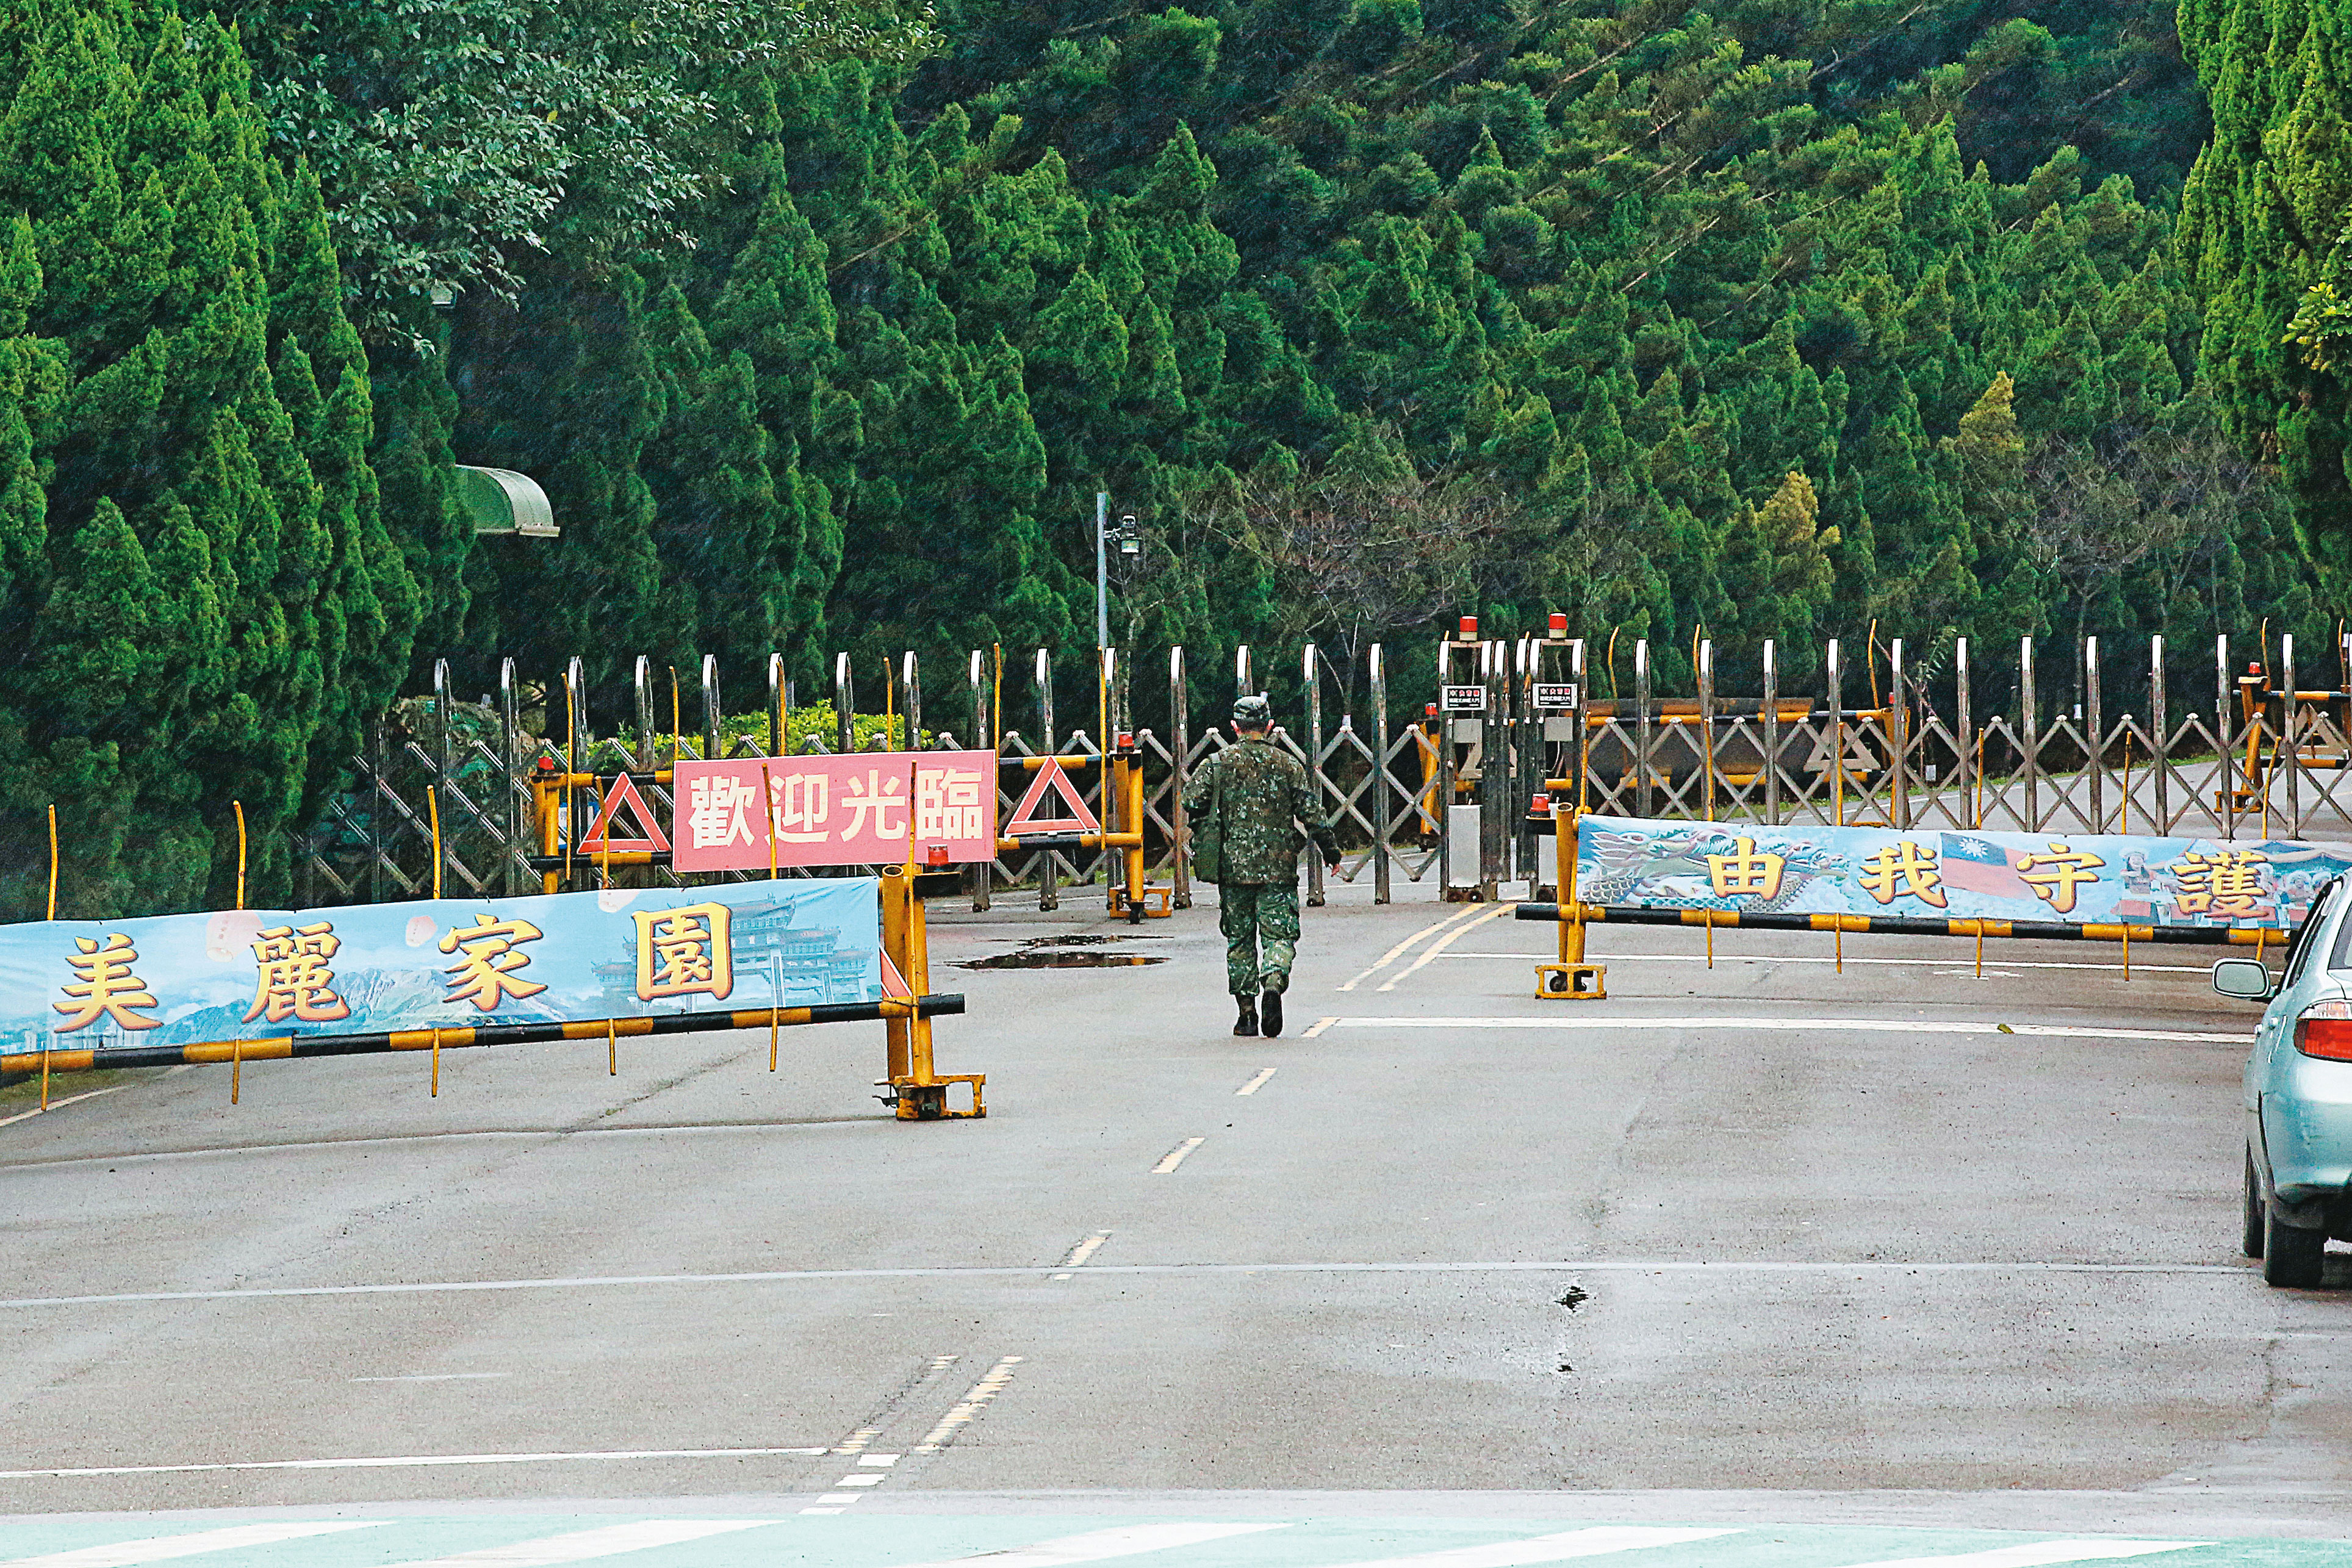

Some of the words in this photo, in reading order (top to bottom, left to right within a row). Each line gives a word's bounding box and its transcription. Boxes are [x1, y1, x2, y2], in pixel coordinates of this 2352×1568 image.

[689, 768, 984, 849] 歡迎光臨
[1704, 836, 2268, 918] 由我守護
[52, 901, 735, 1034] 美麗家園
